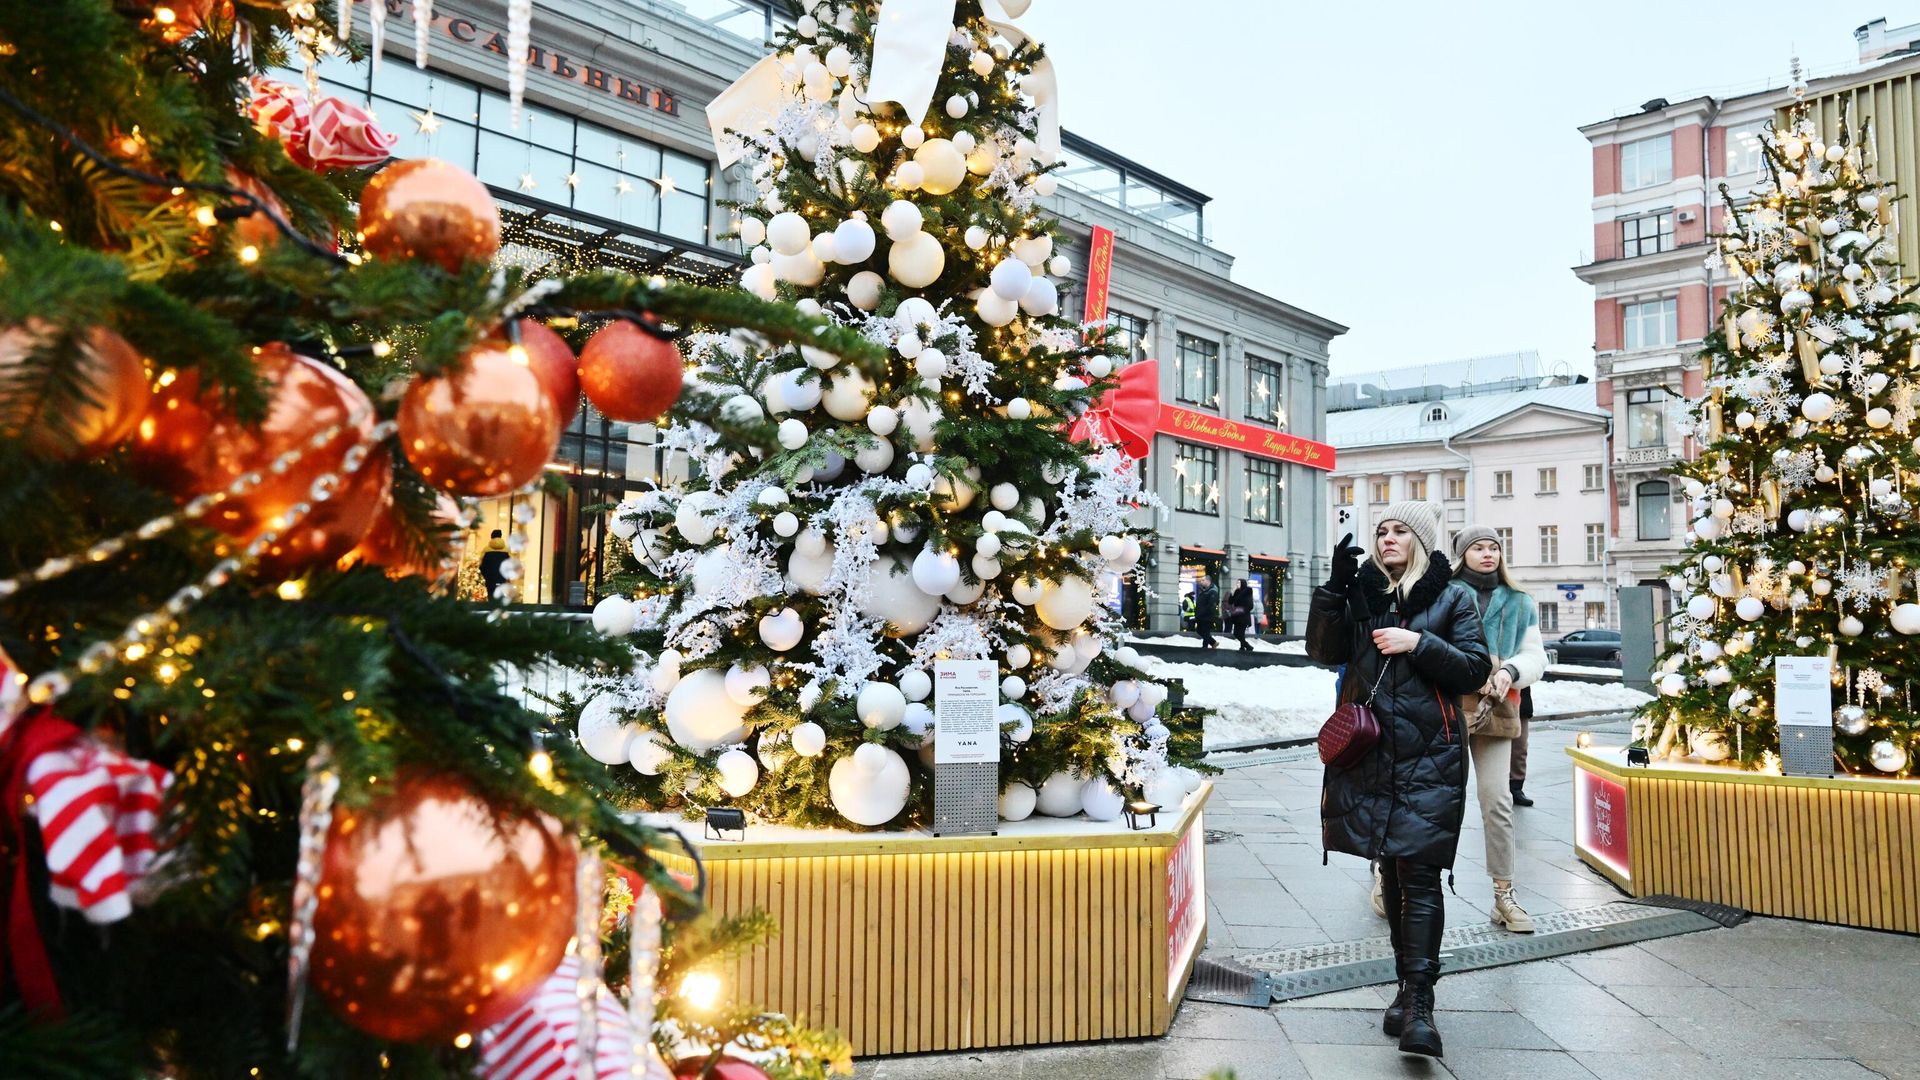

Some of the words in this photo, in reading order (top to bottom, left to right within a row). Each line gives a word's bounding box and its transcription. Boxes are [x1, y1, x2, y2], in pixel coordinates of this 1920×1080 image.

[1263, 432, 1286, 456] Happy
[1285, 440, 1302, 455] New
[1304, 444, 1321, 461] Year
[1168, 834, 1193, 922] ЗИМ
